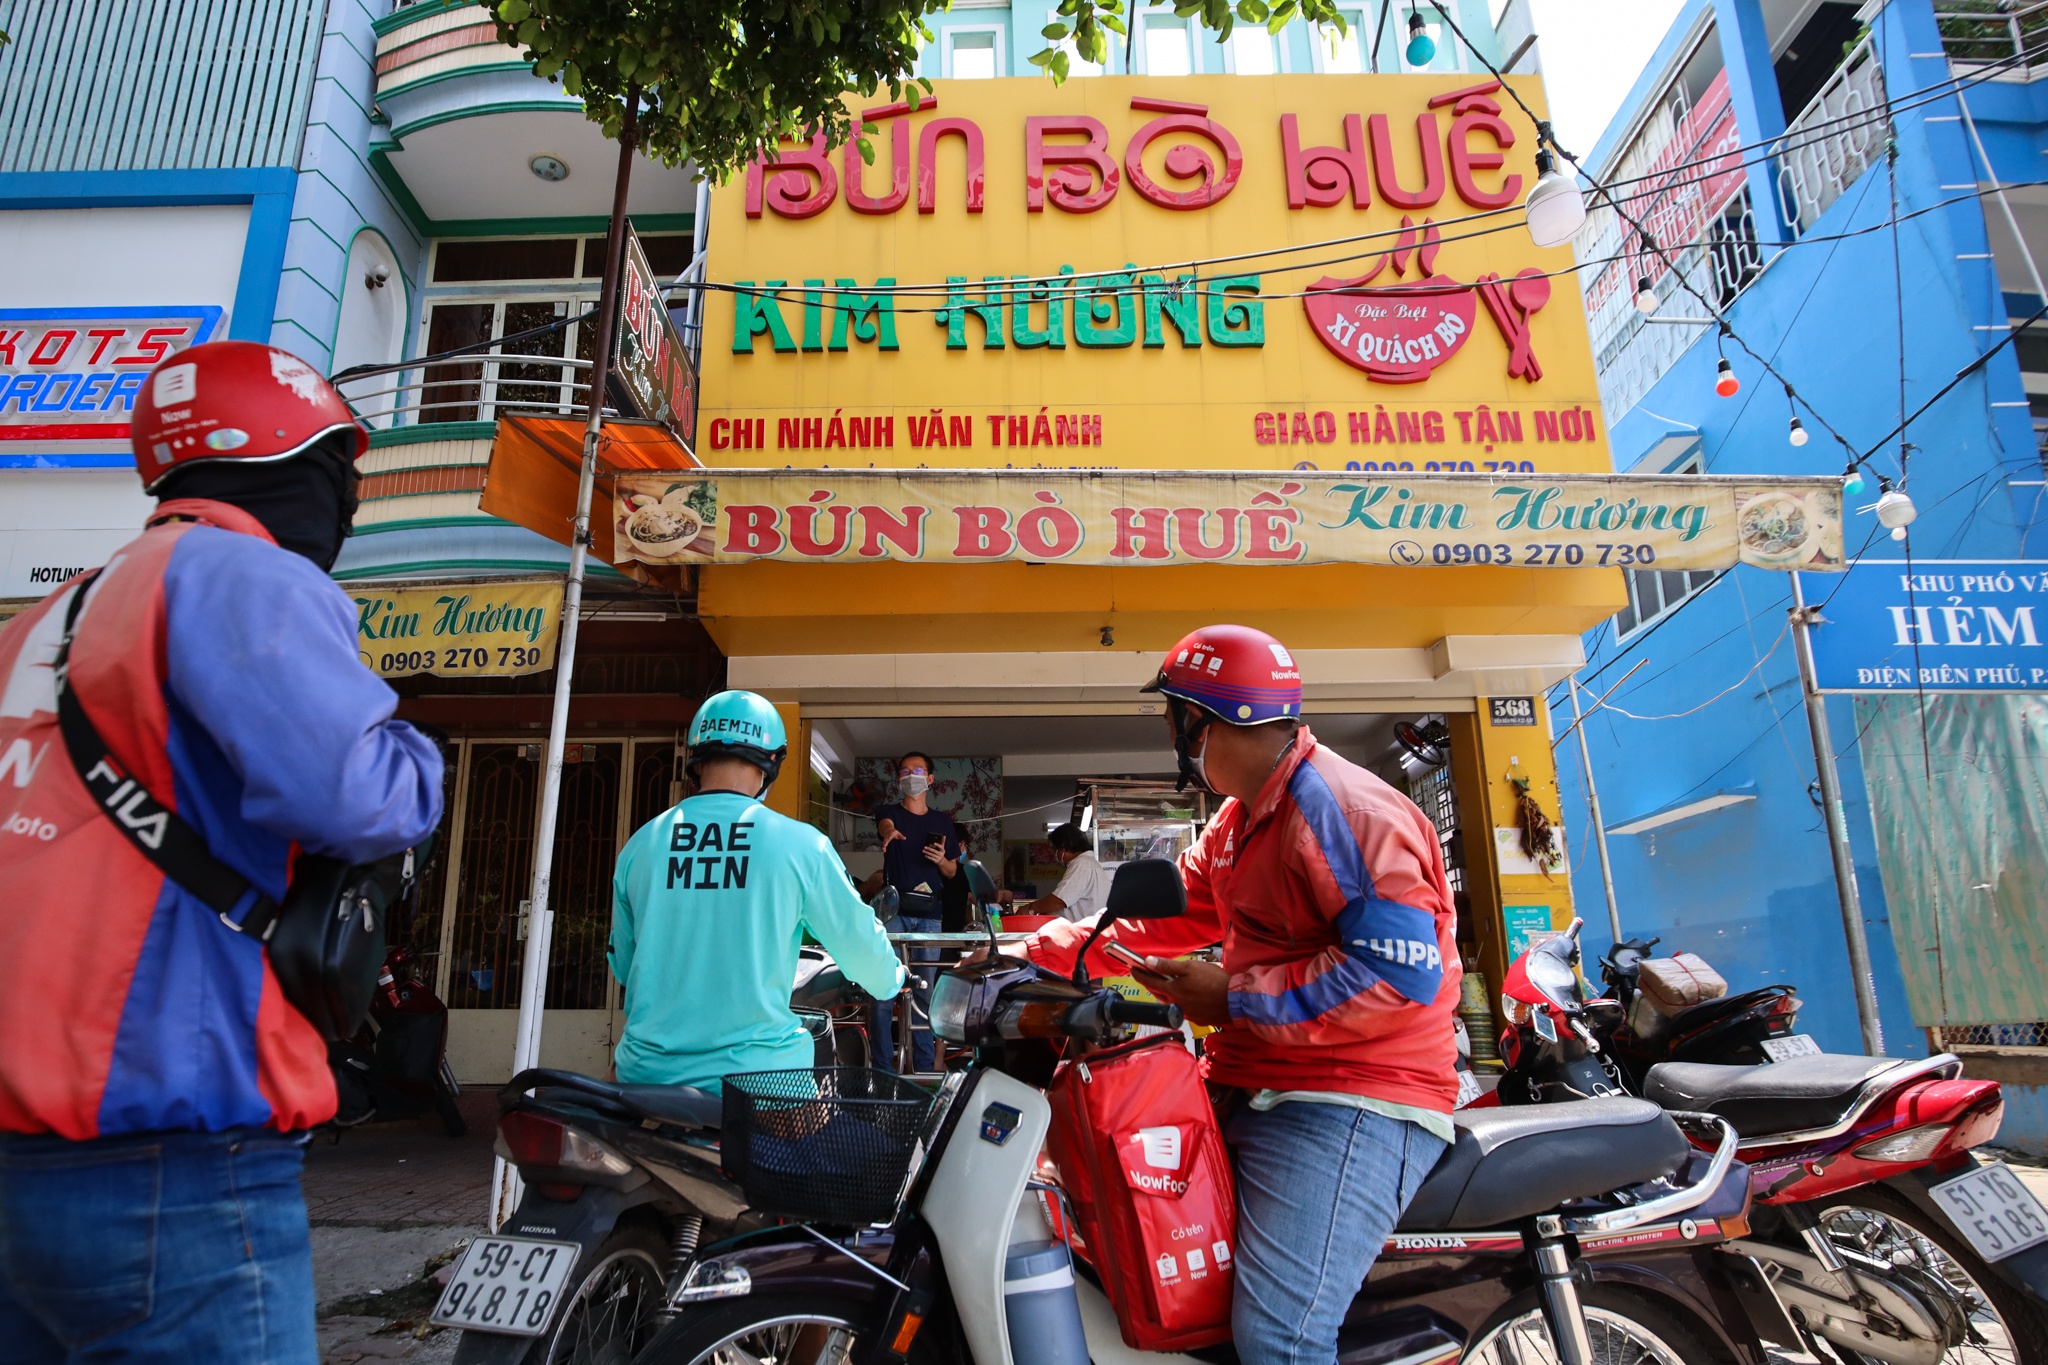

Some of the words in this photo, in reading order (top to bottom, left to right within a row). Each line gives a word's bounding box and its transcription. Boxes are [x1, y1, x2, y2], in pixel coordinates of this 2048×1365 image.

[745, 96, 984, 219] BÚN
[1026, 96, 1243, 214] BÒ
[1280, 79, 1522, 210] HUẾ
[625, 259, 671, 393] BÚN
[731, 277, 900, 355] KIM
[935, 263, 1265, 350] HƯƠNG
[1354, 303, 1388, 322] Đặc
[1393, 303, 1428, 322] Biệt
[1326, 312, 1360, 347] XÍ
[1356, 333, 1440, 364] QUÁCH
[1434, 310, 1465, 348] BÒ
[0, 372, 150, 412] RDER
[709, 416, 765, 450] CHI
[777, 408, 895, 449] NHÁNH
[907, 409, 973, 448] VĂN
[986, 406, 1103, 448] THÁNH
[1253, 410, 1336, 445] GIAO
[1349, 403, 1446, 443] HÀNG
[1453, 404, 1524, 452] TẬN
[1535, 406, 1597, 443] NƠI
[721, 488, 932, 558] BÚN
[951, 488, 1086, 558] BÒ
[1108, 481, 1309, 560] HUẾ
[1317, 483, 1476, 532] Kim
[1491, 485, 1716, 543] Hương
[1431, 542, 1513, 566] 0903
[1523, 542, 1585, 566] 270
[1595, 543, 1656, 566] 730
[1899, 574, 1955, 593] KHU
[1960, 570, 2016, 593] PHỐ
[352, 595, 423, 640] Kim
[432, 593, 548, 643] Hương
[1885, 595, 2044, 647] HẺM
[380, 650, 436, 672] 0903
[443, 647, 489, 668] 270
[497, 646, 542, 667] 730
[1857, 666, 1912, 688] ĐIỆN
[1918, 663, 1969, 684] BIÊN
[1494, 699, 1531, 717] 568
[700, 718, 762, 739] BAEMIN
[86, 754, 169, 849] FILA
[670, 821, 755, 852] BAE
[666, 855, 749, 890] MIN
[1352, 938, 1444, 974] HIPP
[520, 1225, 557, 1235] HONDA
[1171, 1227, 1185, 1240] Có
[1186, 1223, 1204, 1237] trên
[1395, 1236, 1468, 1249] HONDA
[1587, 1237, 1625, 1249] ELECTRIC
[1626, 1231, 1664, 1242] STARTER
[1973, 1202, 2046, 1250] 5185
[473, 1242, 559, 1284] 59-C1
[1190, 1269, 1208, 1281] Now
[442, 1281, 552, 1328] 948.18
